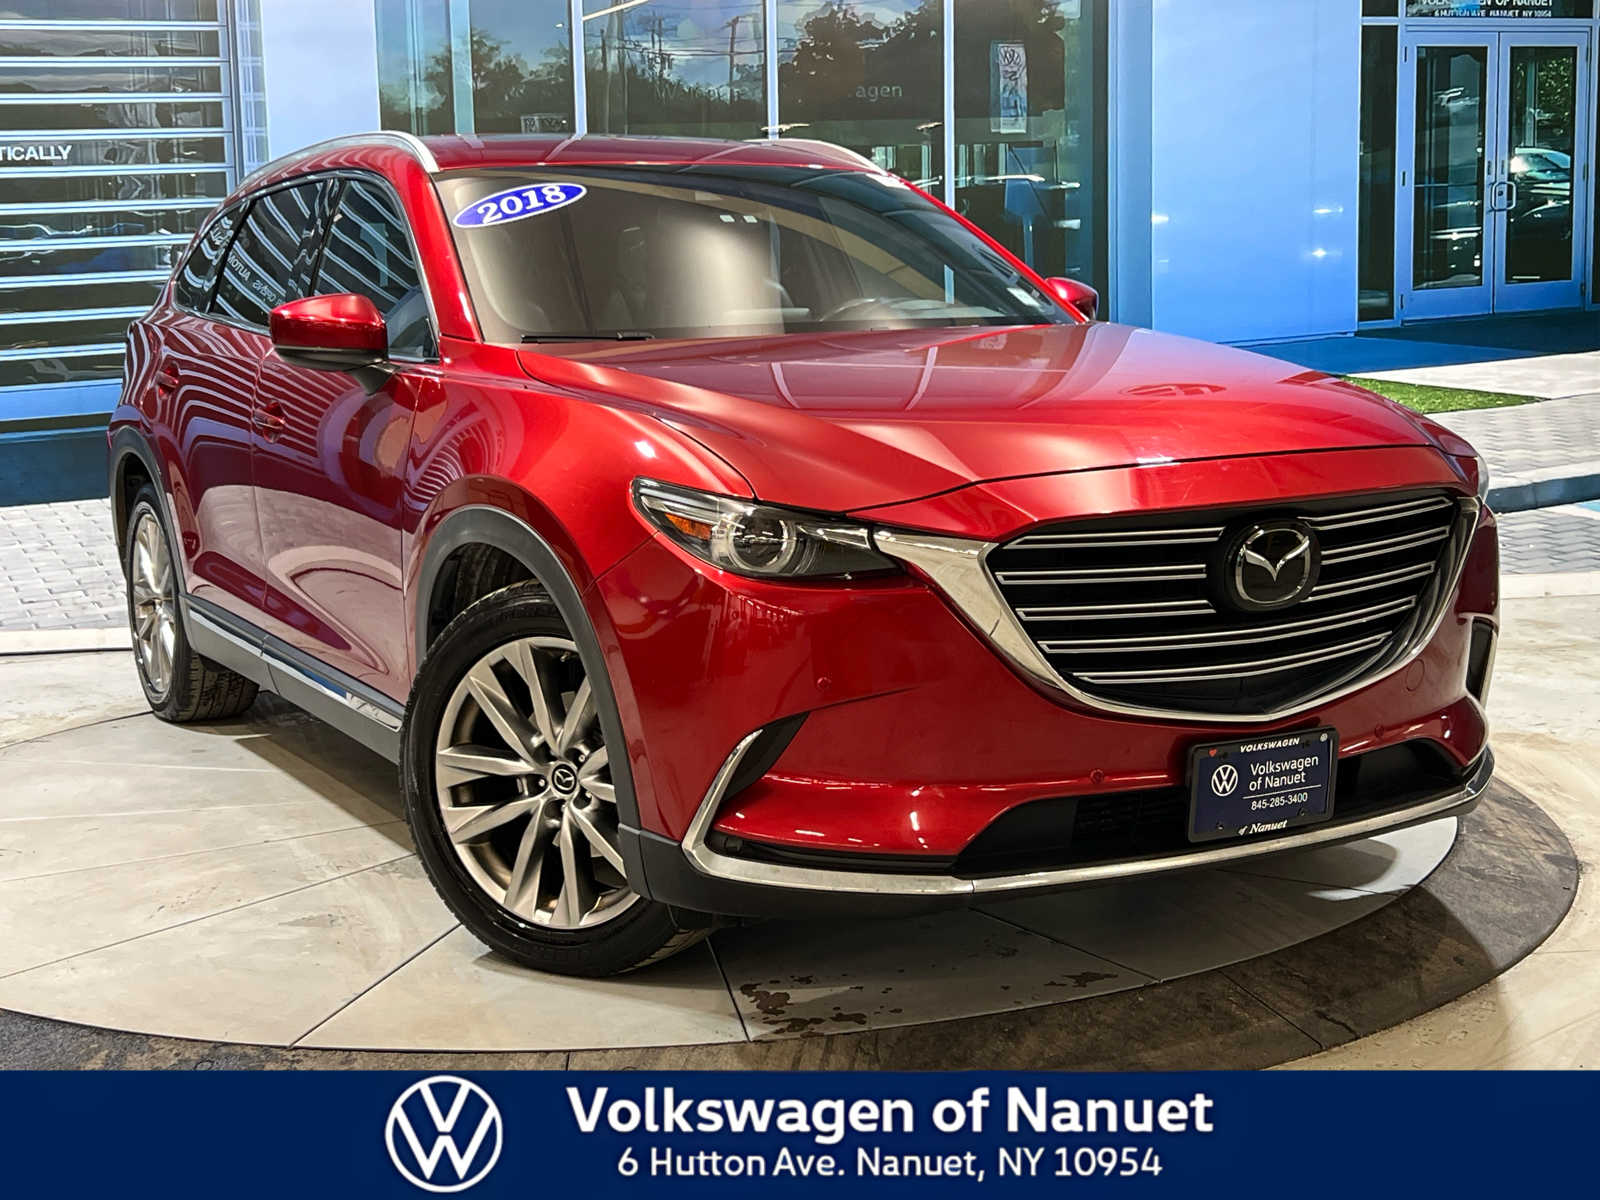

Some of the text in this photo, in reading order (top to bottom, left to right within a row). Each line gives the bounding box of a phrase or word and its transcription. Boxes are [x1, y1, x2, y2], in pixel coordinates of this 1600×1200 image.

[477, 185, 566, 224] 2018
[1240, 737, 1300, 752] VOLKSWAGEN
[1250, 756, 1319, 776] Volkswagen
[1249, 771, 1306, 791] of Nanuet
[1251, 792, 1308, 810] 845-285-3400
[1249, 819, 1288, 834] Nanuet
